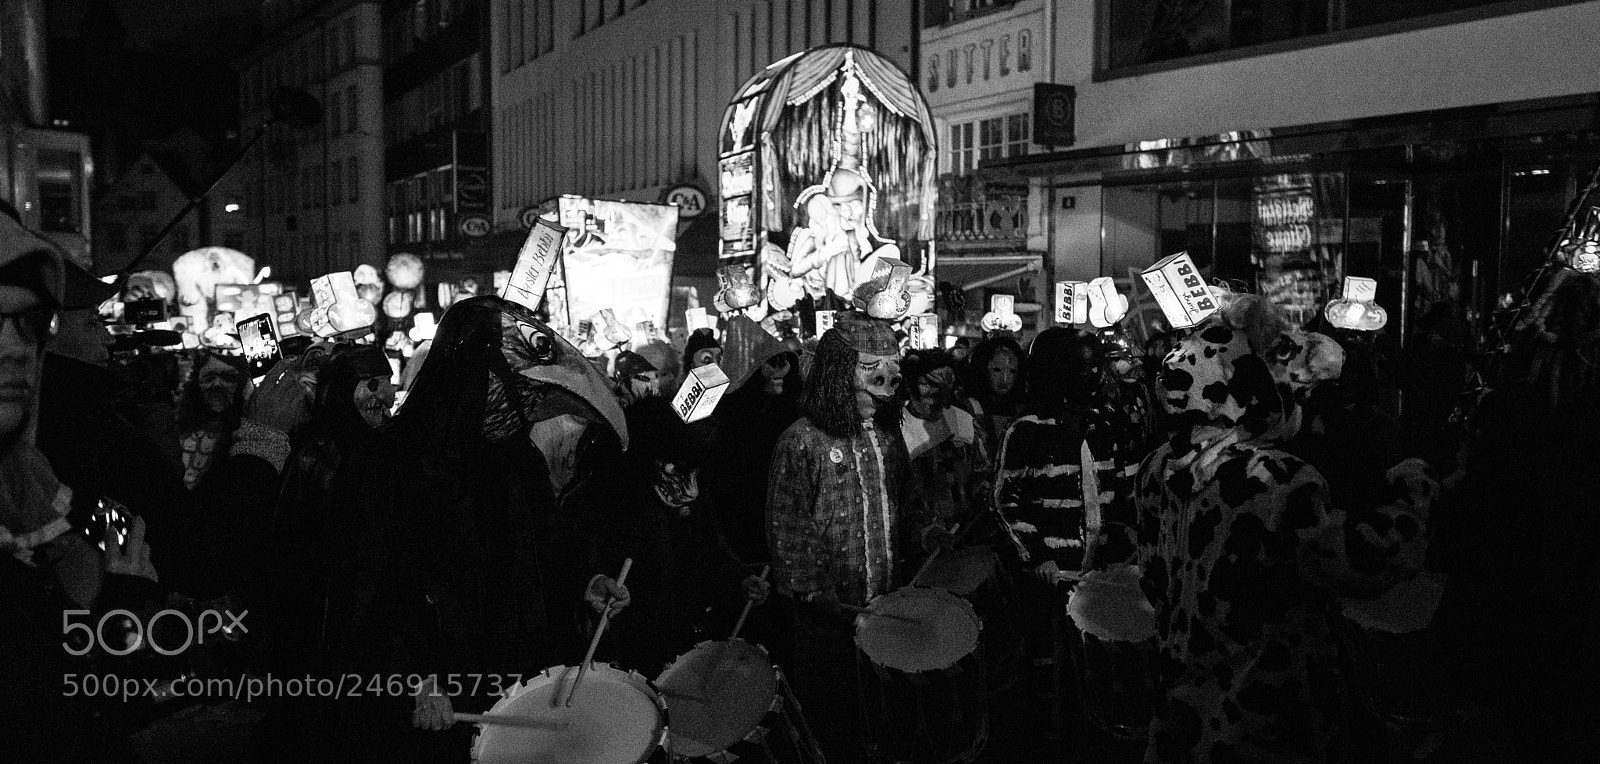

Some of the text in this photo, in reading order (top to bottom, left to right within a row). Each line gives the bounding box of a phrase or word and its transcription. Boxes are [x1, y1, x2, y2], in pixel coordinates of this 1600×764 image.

[928, 28, 1032, 93] SUTTER
[673, 193, 700, 210] C&A
[532, 231, 554, 268] Bebbi
[1062, 283, 1073, 321] BEBBI
[1174, 259, 1215, 311] BEBBI
[680, 382, 702, 418] BEBBI
